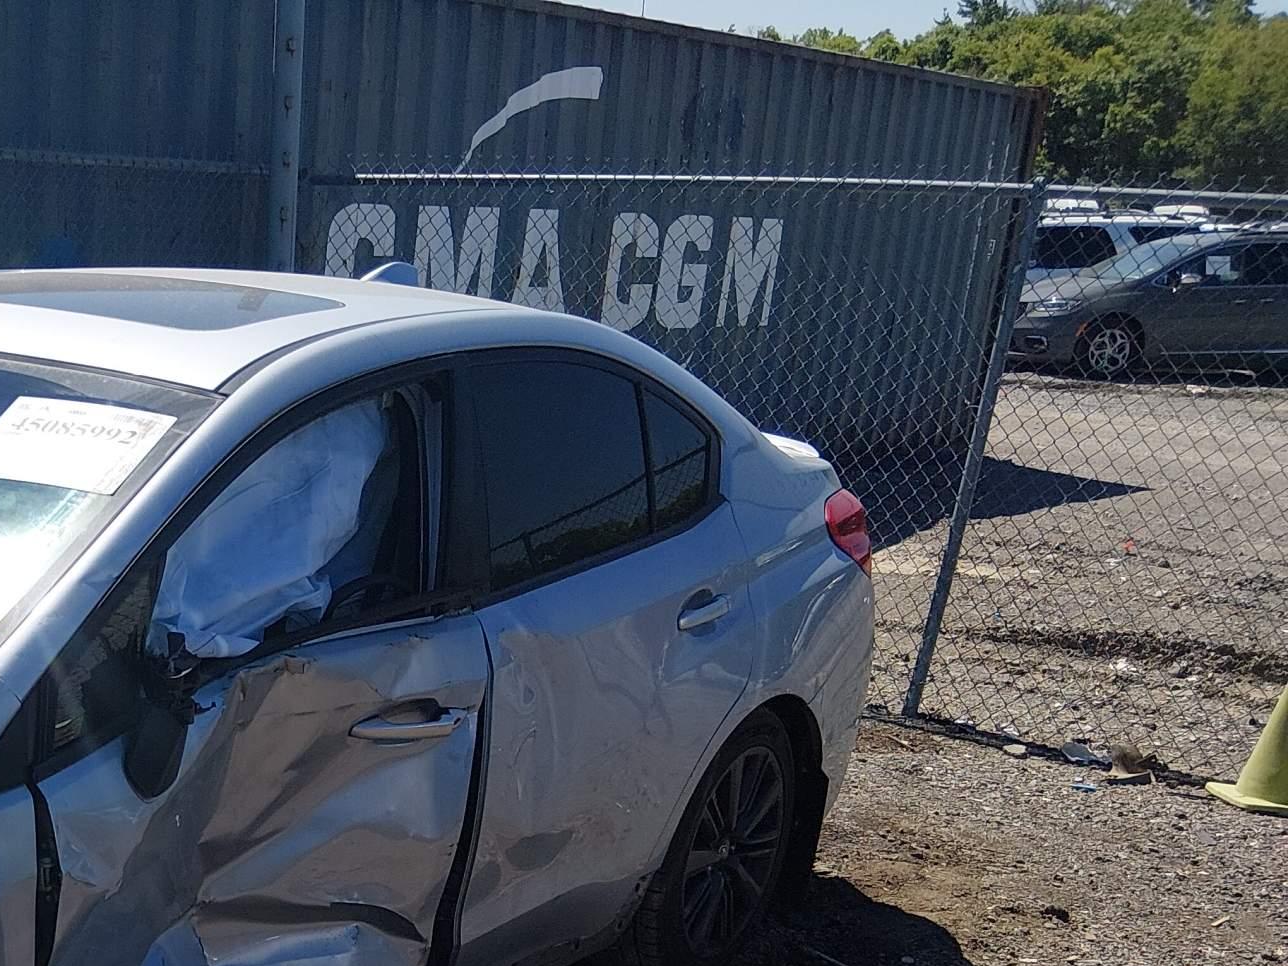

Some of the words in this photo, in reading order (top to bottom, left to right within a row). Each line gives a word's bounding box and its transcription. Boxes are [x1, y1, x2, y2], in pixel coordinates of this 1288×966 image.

[324, 203, 565, 314] CMA
[601, 212, 783, 332] CGM
[11, 416, 137, 445] 45085992
